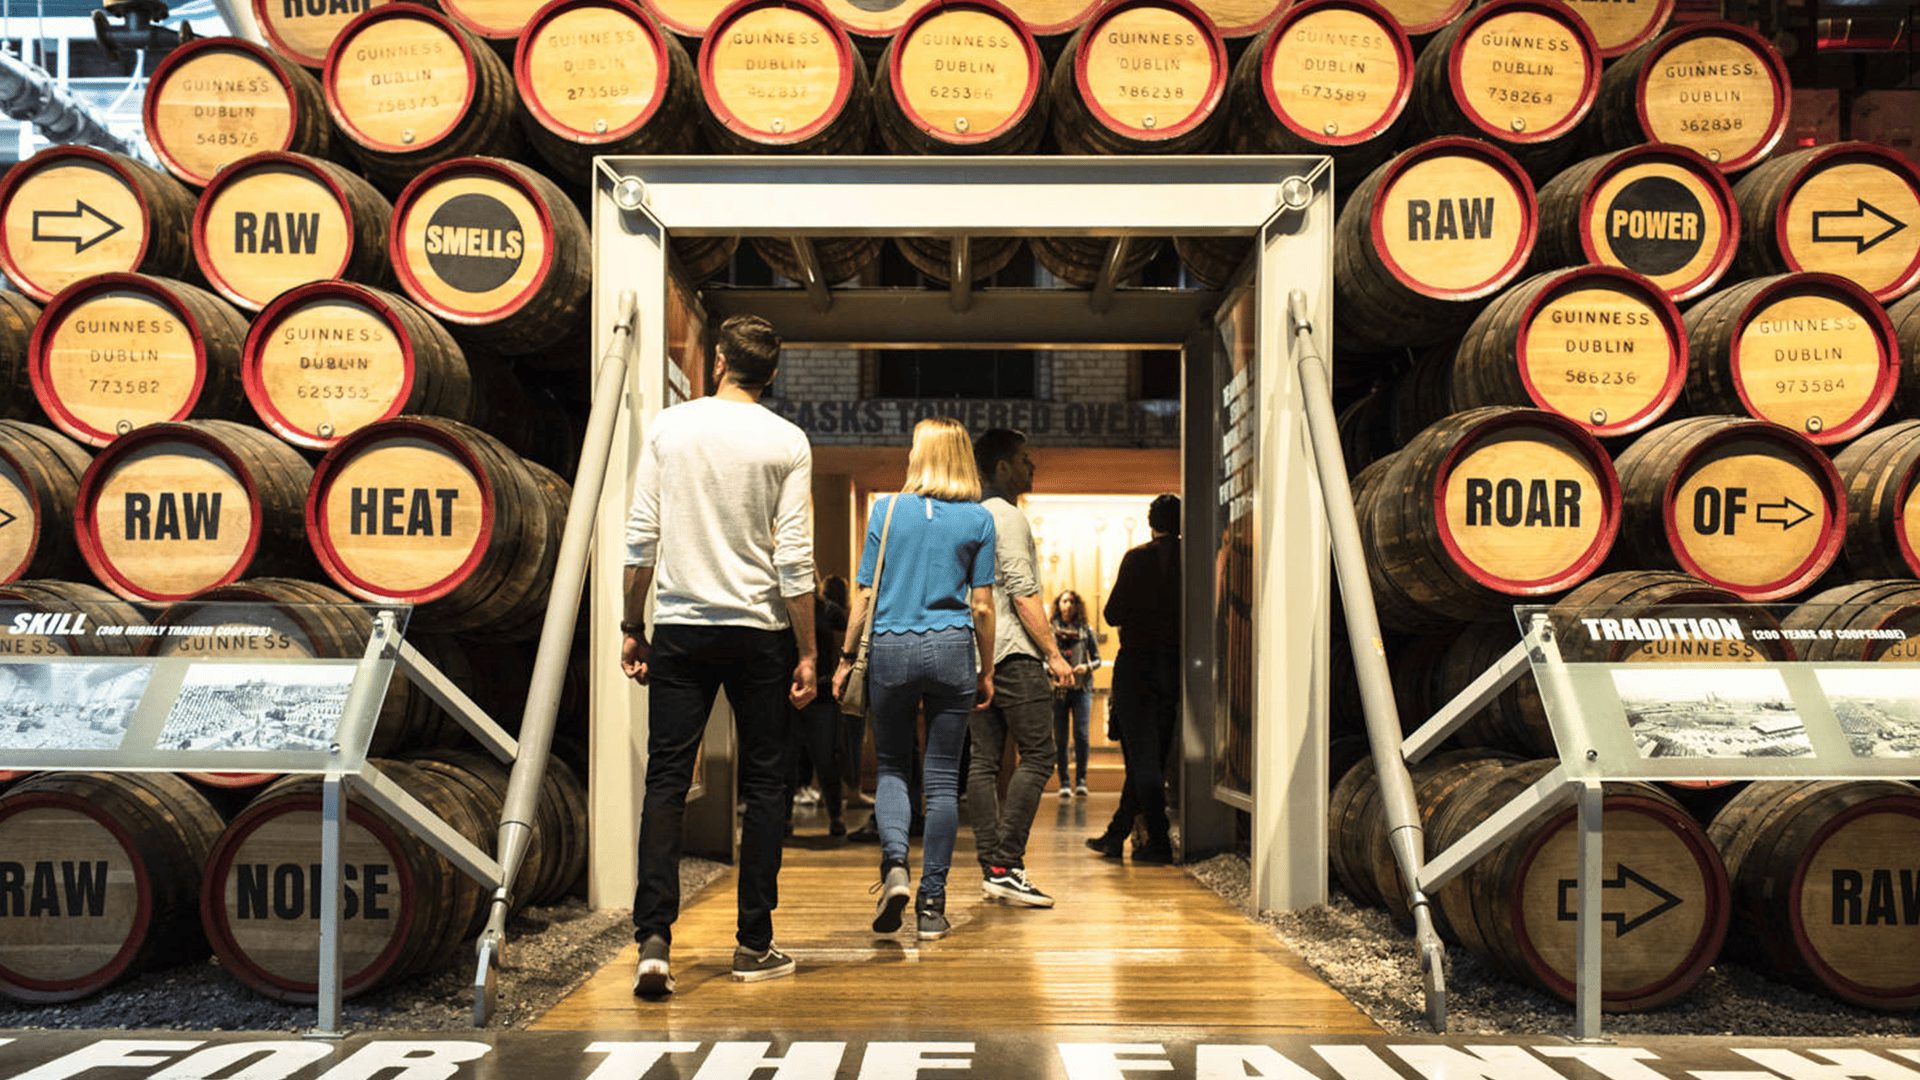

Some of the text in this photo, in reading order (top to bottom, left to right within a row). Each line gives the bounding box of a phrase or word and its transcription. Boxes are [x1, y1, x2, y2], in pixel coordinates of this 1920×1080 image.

[549, 30, 635, 48] GUINNESS
[733, 33, 820, 45] GUINNESS
[922, 34, 1009, 49] GUINNESS
[1108, 32, 1195, 46] GUINNESS
[1296, 30, 1383, 50] GUINNESS
[1481, 34, 1569, 52] GUINNESS
[356, 42, 443, 62] GUINNESS
[745, 58, 807, 71] DUBLIN
[934, 59, 996, 74] DUBLIN
[1119, 57, 1181, 71] DUBLIN
[1304, 58, 1366, 74] DUBLIN
[1491, 60, 1554, 77] DUBLIN
[1665, 63, 1754, 79] GUINNESS
[182, 79, 271, 93] GUINNESS
[371, 69, 432, 87] DUBLIN
[566, 85, 630, 101] 273589
[1118, 85, 1184, 99] 386238
[1301, 85, 1368, 102] 673589
[1488, 87, 1554, 105] 738264
[1679, 90, 1742, 104] DUBLIN
[193, 105, 256, 118] DUBLIN
[1680, 119, 1744, 133] 362838
[196, 132, 259, 145] 548576
[1407, 197, 1495, 241] RAW
[1612, 209, 1699, 241] POWER
[234, 212, 320, 255] RAW
[426, 224, 523, 260] SMELLS
[1551, 305, 1650, 326] GUINNESS
[75, 320, 175, 334] GUINNESS
[1760, 318, 1857, 334] GUINNESS
[284, 327, 383, 342] GUINNESS
[1565, 339, 1635, 353] DUBLIN
[89, 349, 159, 363] DUBLIN
[1774, 347, 1843, 362] DUBLIN
[300, 357, 368, 370] DUBLIN
[1565, 369, 1638, 385] 586236
[88, 379, 160, 394] 773582
[297, 385, 369, 400] 625353
[1775, 378, 1846, 394] 973584
[1064, 401, 1147, 434] OVER
[1465, 477, 1582, 528] ROAR
[124, 491, 222, 541] RAW
[349, 487, 459, 538] HEAT
[1692, 486, 1747, 536] OF
[8, 612, 88, 636] SKILL
[124, 625, 168, 636] HIGHLY
[167, 626, 214, 636] TRAINED
[215, 626, 272, 637] COOPERS)
[1580, 617, 1907, 641] TRADITION (200 YEARS OF COOPERAGE)
[179, 634, 291, 652] GUINNESS
[1641, 640, 1755, 658] GUINNESS
[0, 861, 108, 917] RAW
[5, 1039, 493, 1080] FOR
[583, 1041, 976, 1080] THE
